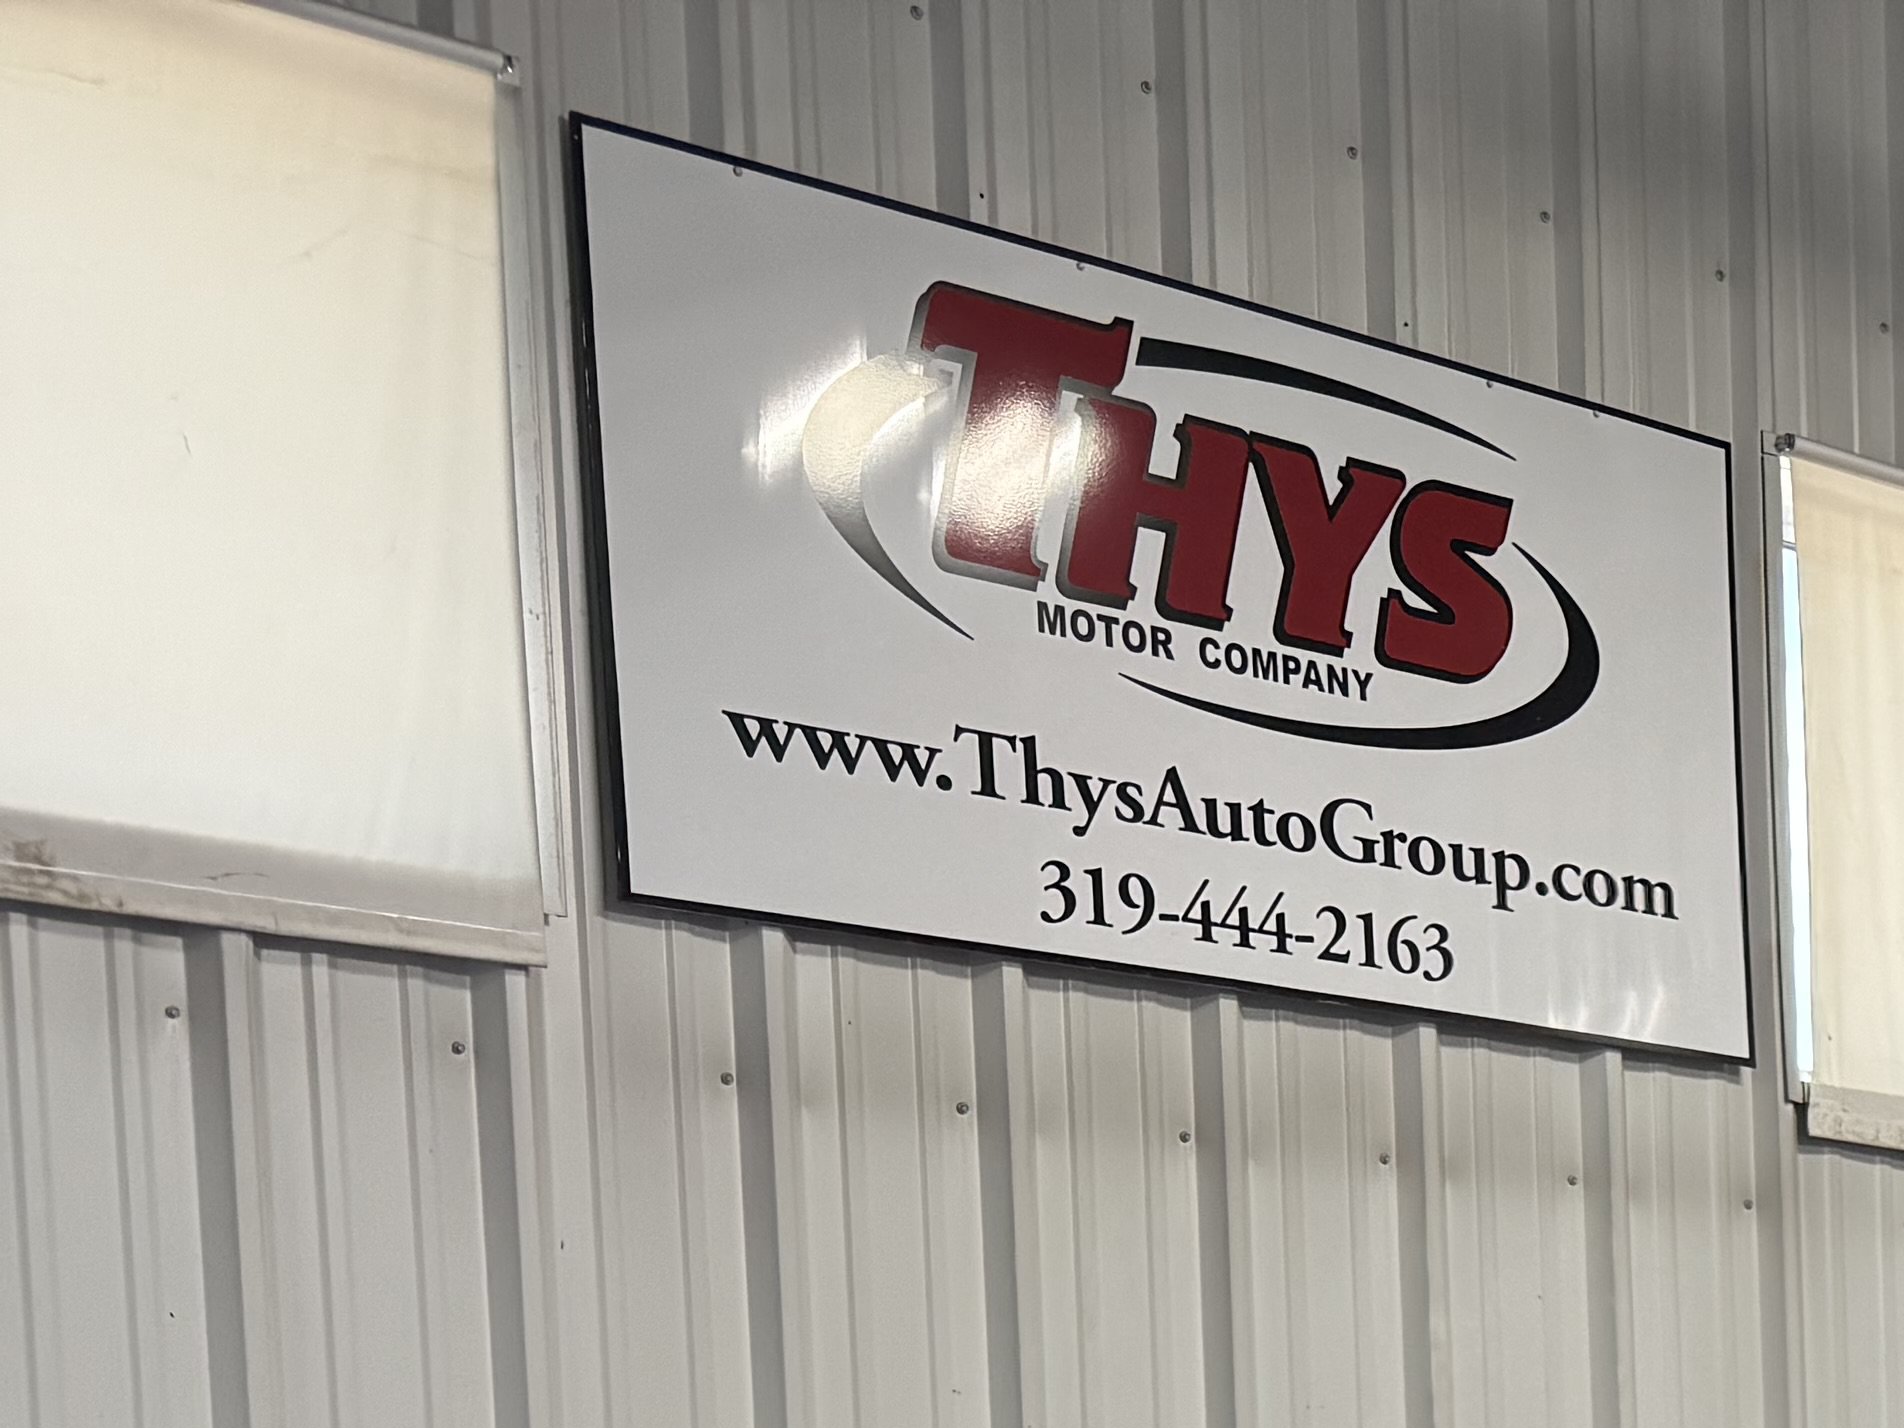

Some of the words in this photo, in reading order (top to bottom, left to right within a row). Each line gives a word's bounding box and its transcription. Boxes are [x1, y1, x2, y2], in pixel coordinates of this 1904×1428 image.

[914, 278, 1514, 684] THYS
[1035, 599, 1174, 660] MOTOR
[1198, 636, 1374, 702] COMPANY
[722, 707, 1680, 921] www.ThysAutoGroup.com
[1038, 859, 1457, 982] 319-444-2163
